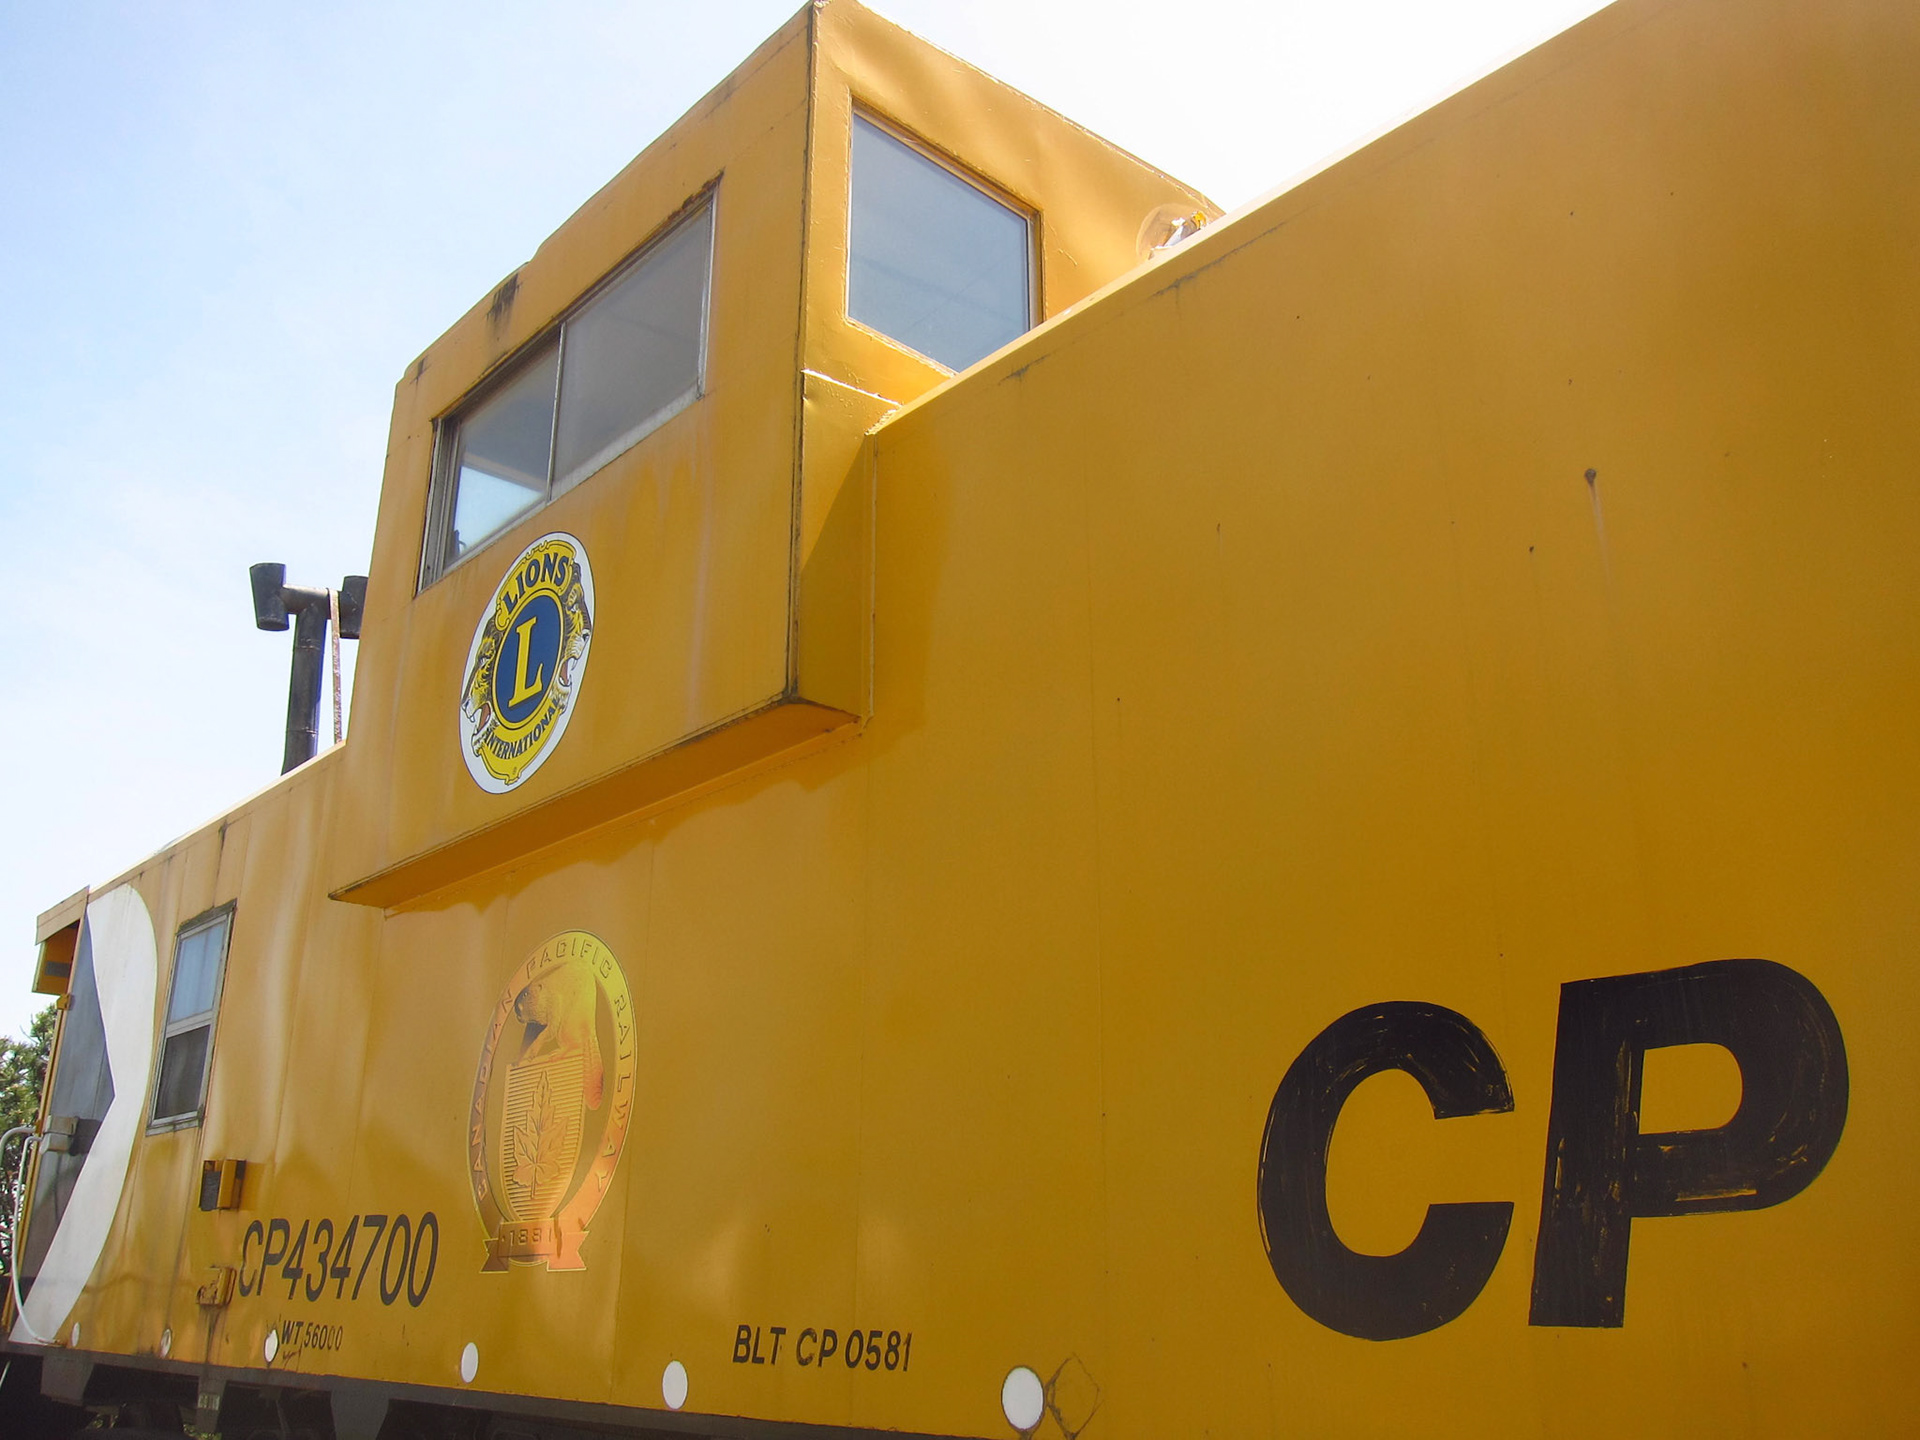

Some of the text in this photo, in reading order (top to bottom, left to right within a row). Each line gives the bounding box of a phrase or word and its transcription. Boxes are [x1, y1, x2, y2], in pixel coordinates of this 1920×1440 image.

[502, 552, 570, 615] LIONS
[508, 616, 544, 708] L
[483, 698, 559, 759] INTERNATIONAL
[526, 937, 612, 980] PACIFIC
[595, 994, 631, 1194] RAILWAY
[1257, 959, 1849, 1341] CP
[238, 1211, 439, 1308] CP434700
[510, 1227, 552, 1246] 1881
[304, 1322, 343, 1351] 56000
[732, 1324, 912, 1372] BLT CP 0581
